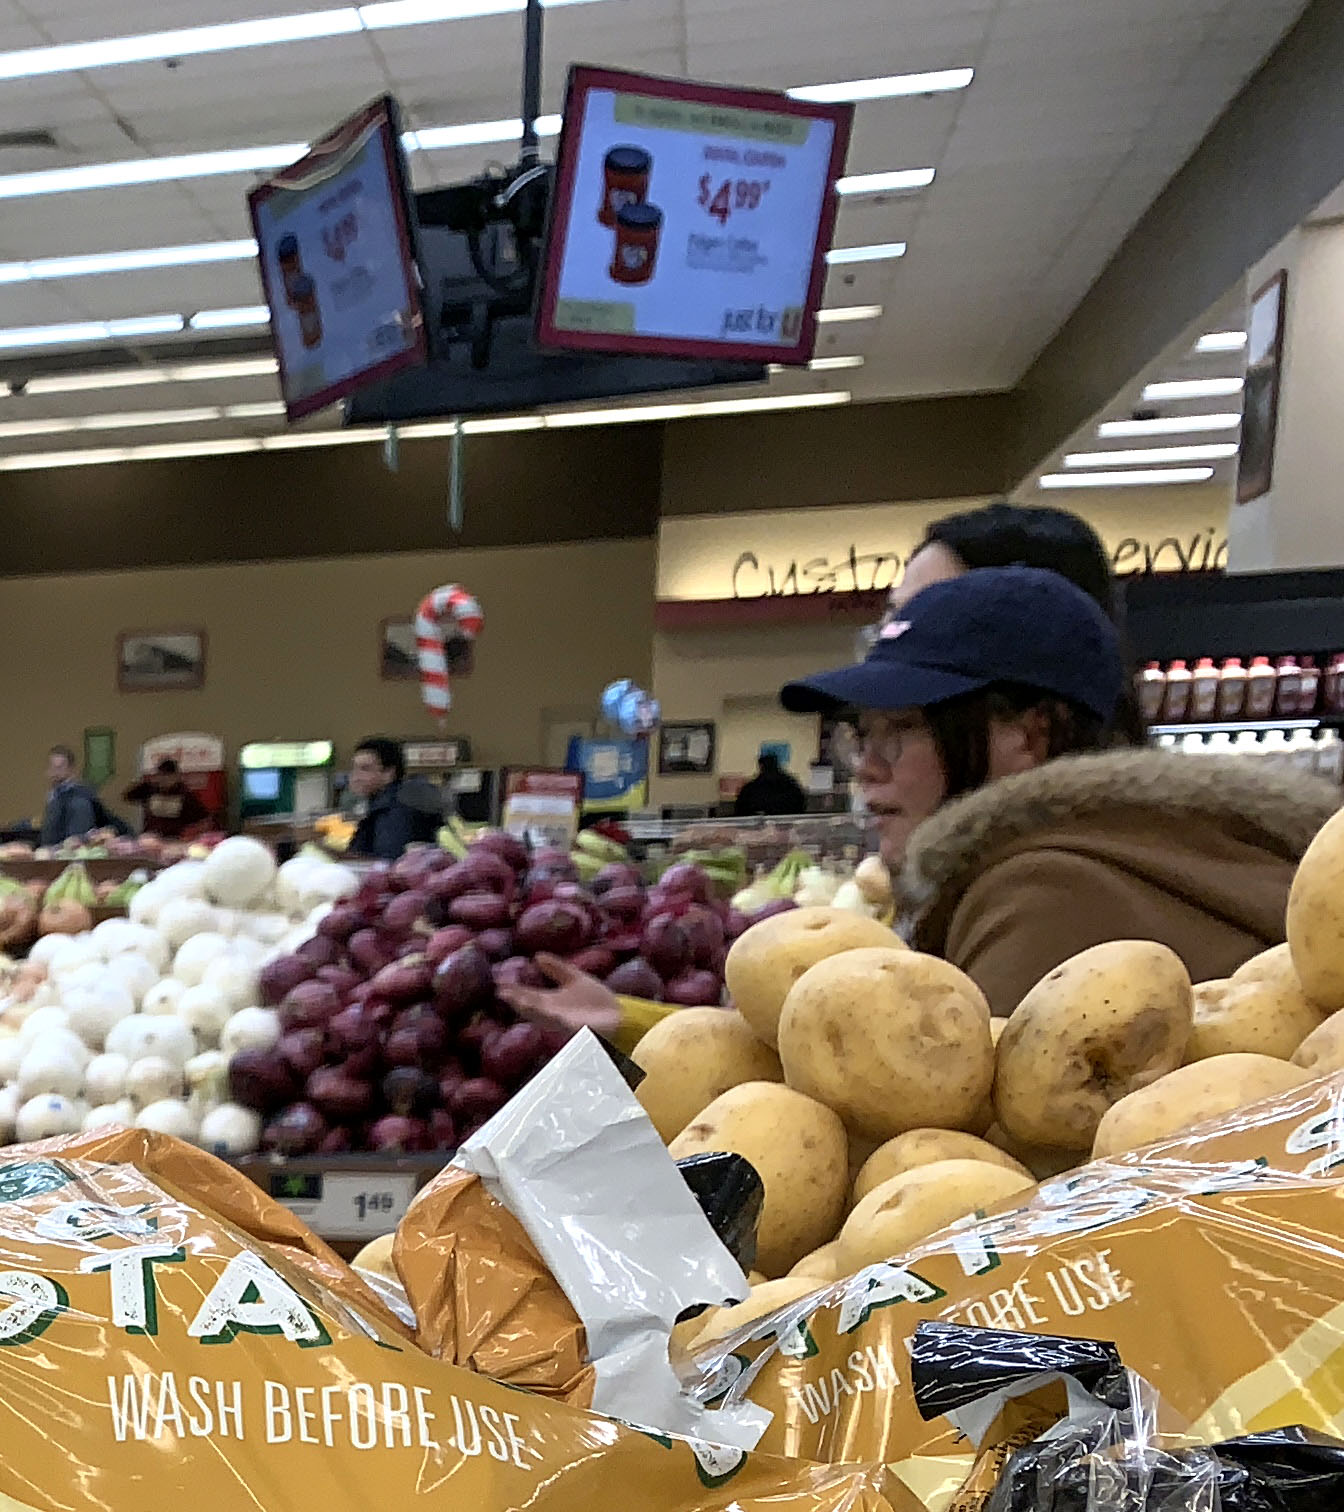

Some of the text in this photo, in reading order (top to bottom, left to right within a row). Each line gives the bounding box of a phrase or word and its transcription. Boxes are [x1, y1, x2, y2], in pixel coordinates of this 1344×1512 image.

[732, 545, 908, 599] Custo
[1112, 526, 1228, 575] ervic
[797, 1344, 901, 1425] WASH
[1046, 1249, 1132, 1317] USE
[107, 1371, 534, 1471] WASH BEFORE USE
